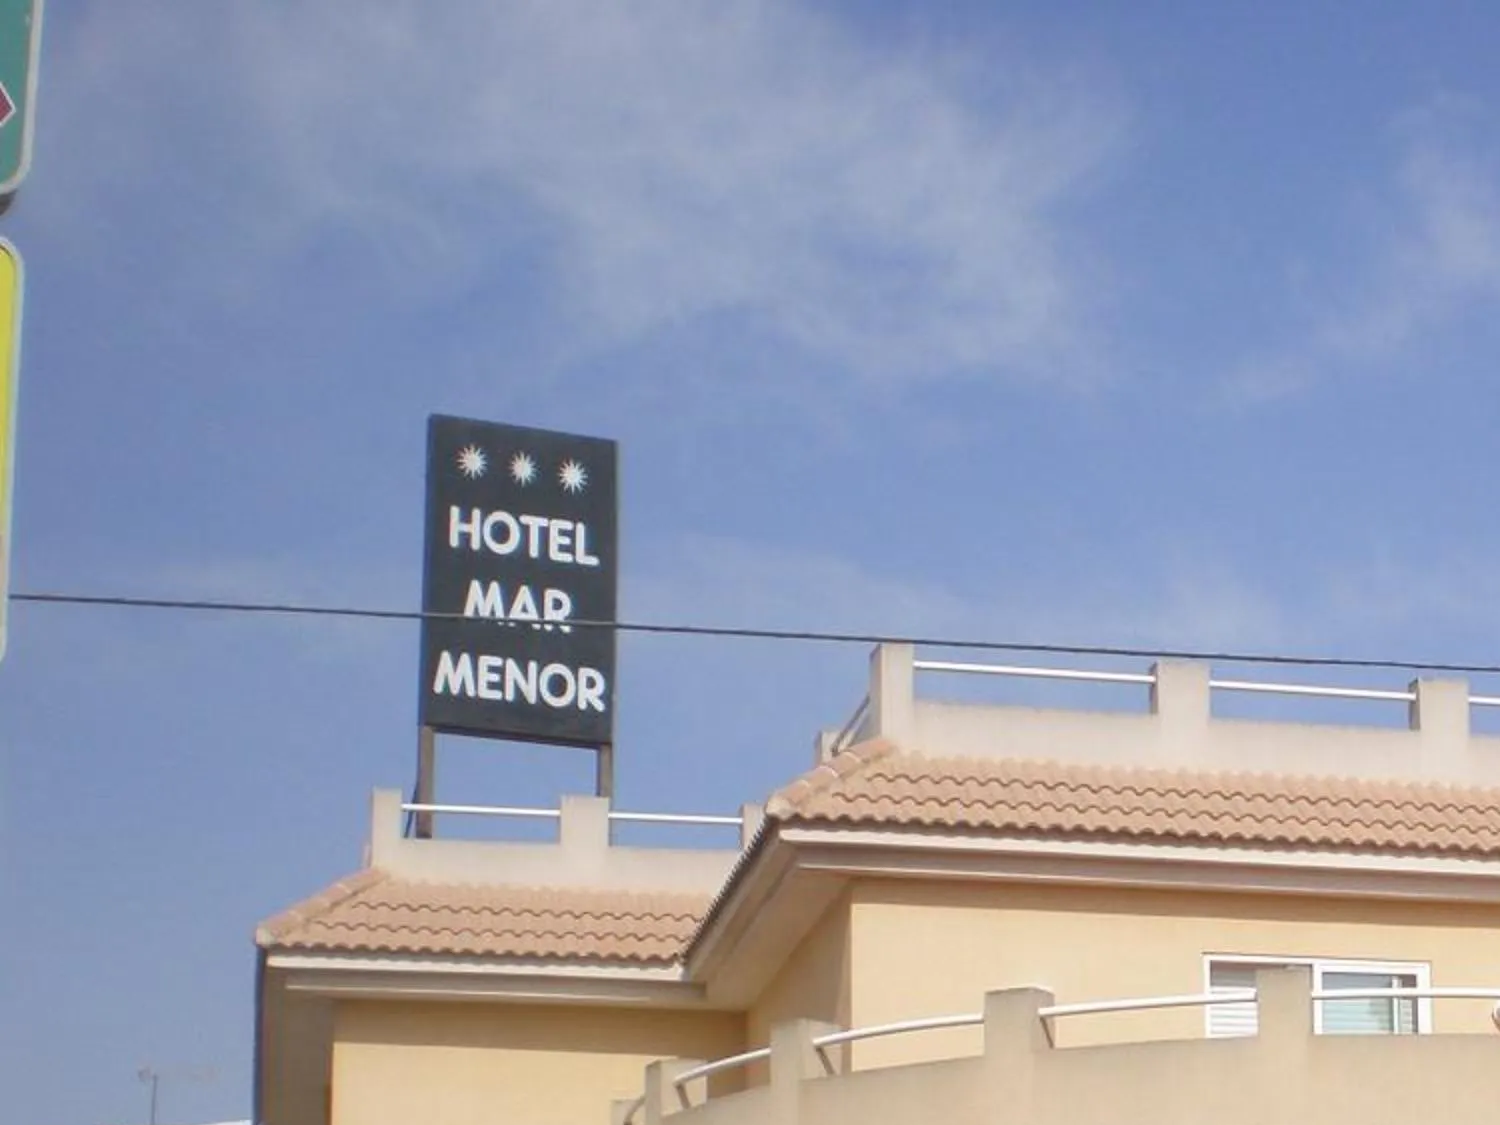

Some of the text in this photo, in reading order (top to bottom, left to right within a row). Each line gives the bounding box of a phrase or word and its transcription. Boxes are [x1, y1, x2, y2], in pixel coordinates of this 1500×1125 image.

[449, 504, 600, 566] HOTEL
[463, 579, 572, 633] MAR
[433, 650, 605, 713] MENOR
